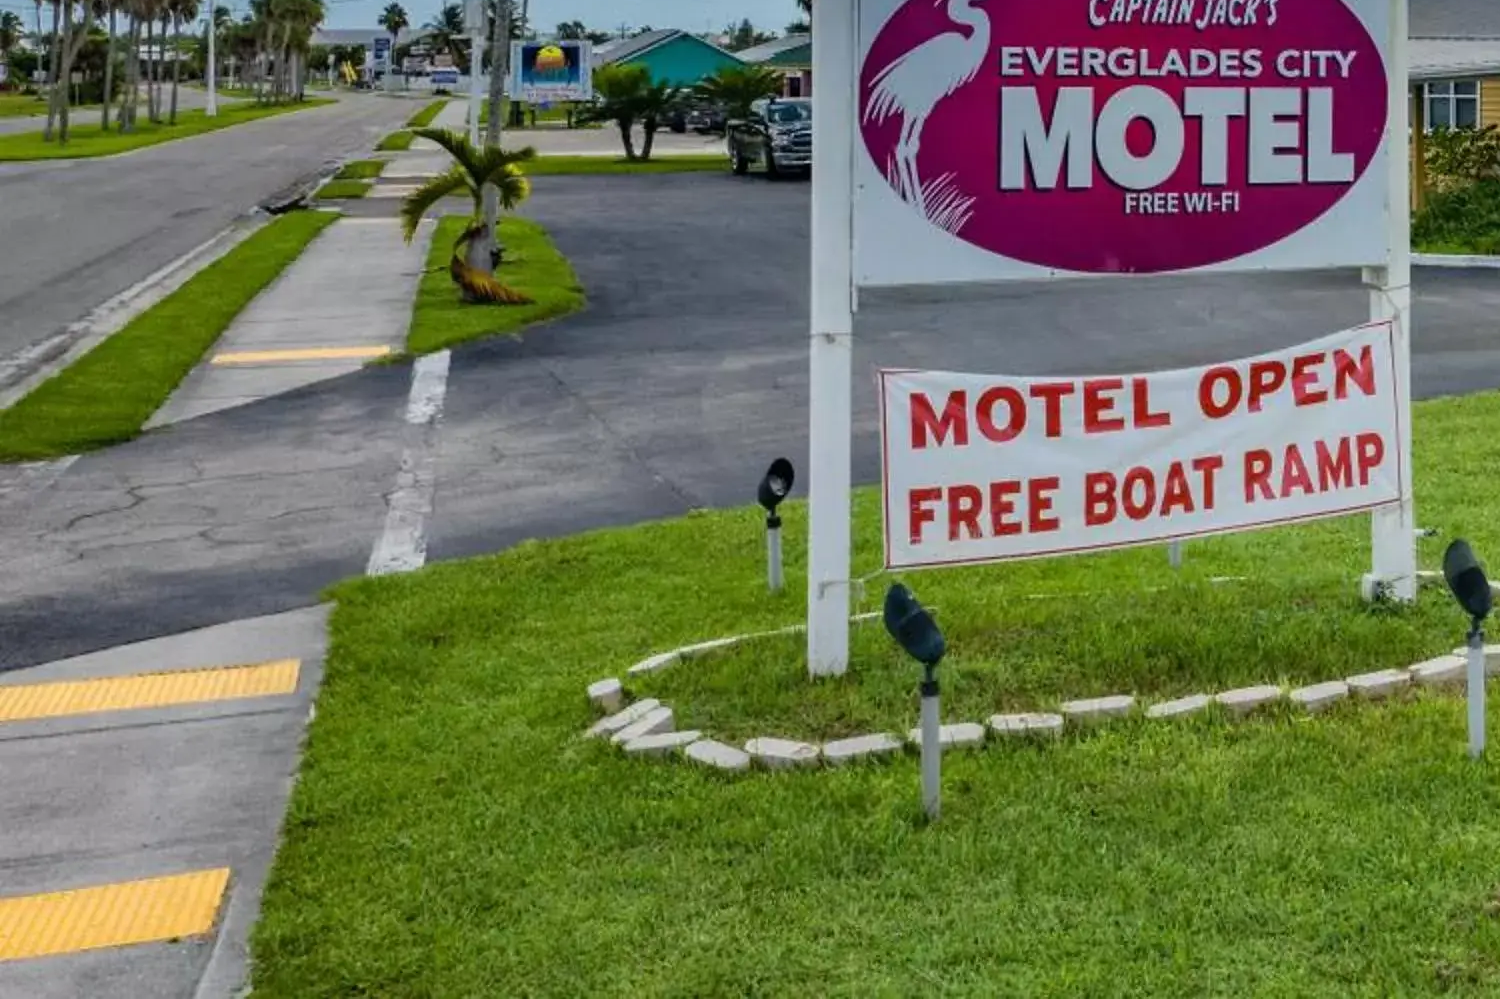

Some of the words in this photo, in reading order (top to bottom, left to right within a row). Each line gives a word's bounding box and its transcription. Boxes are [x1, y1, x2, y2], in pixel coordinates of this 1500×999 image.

[1000, 47, 1263, 78] EVERGLADES
[1276, 51, 1356, 78] CITY
[1000, 85, 1355, 190] MOTEL
[1125, 193, 1179, 214] FREE
[1184, 192, 1240, 213] WI-FI
[910, 377, 1171, 449] MOTEL
[1198, 345, 1376, 419] OPEN
[909, 476, 1060, 545] FREE
[1085, 455, 1223, 527] BOAT
[1244, 433, 1384, 503] RAMP
